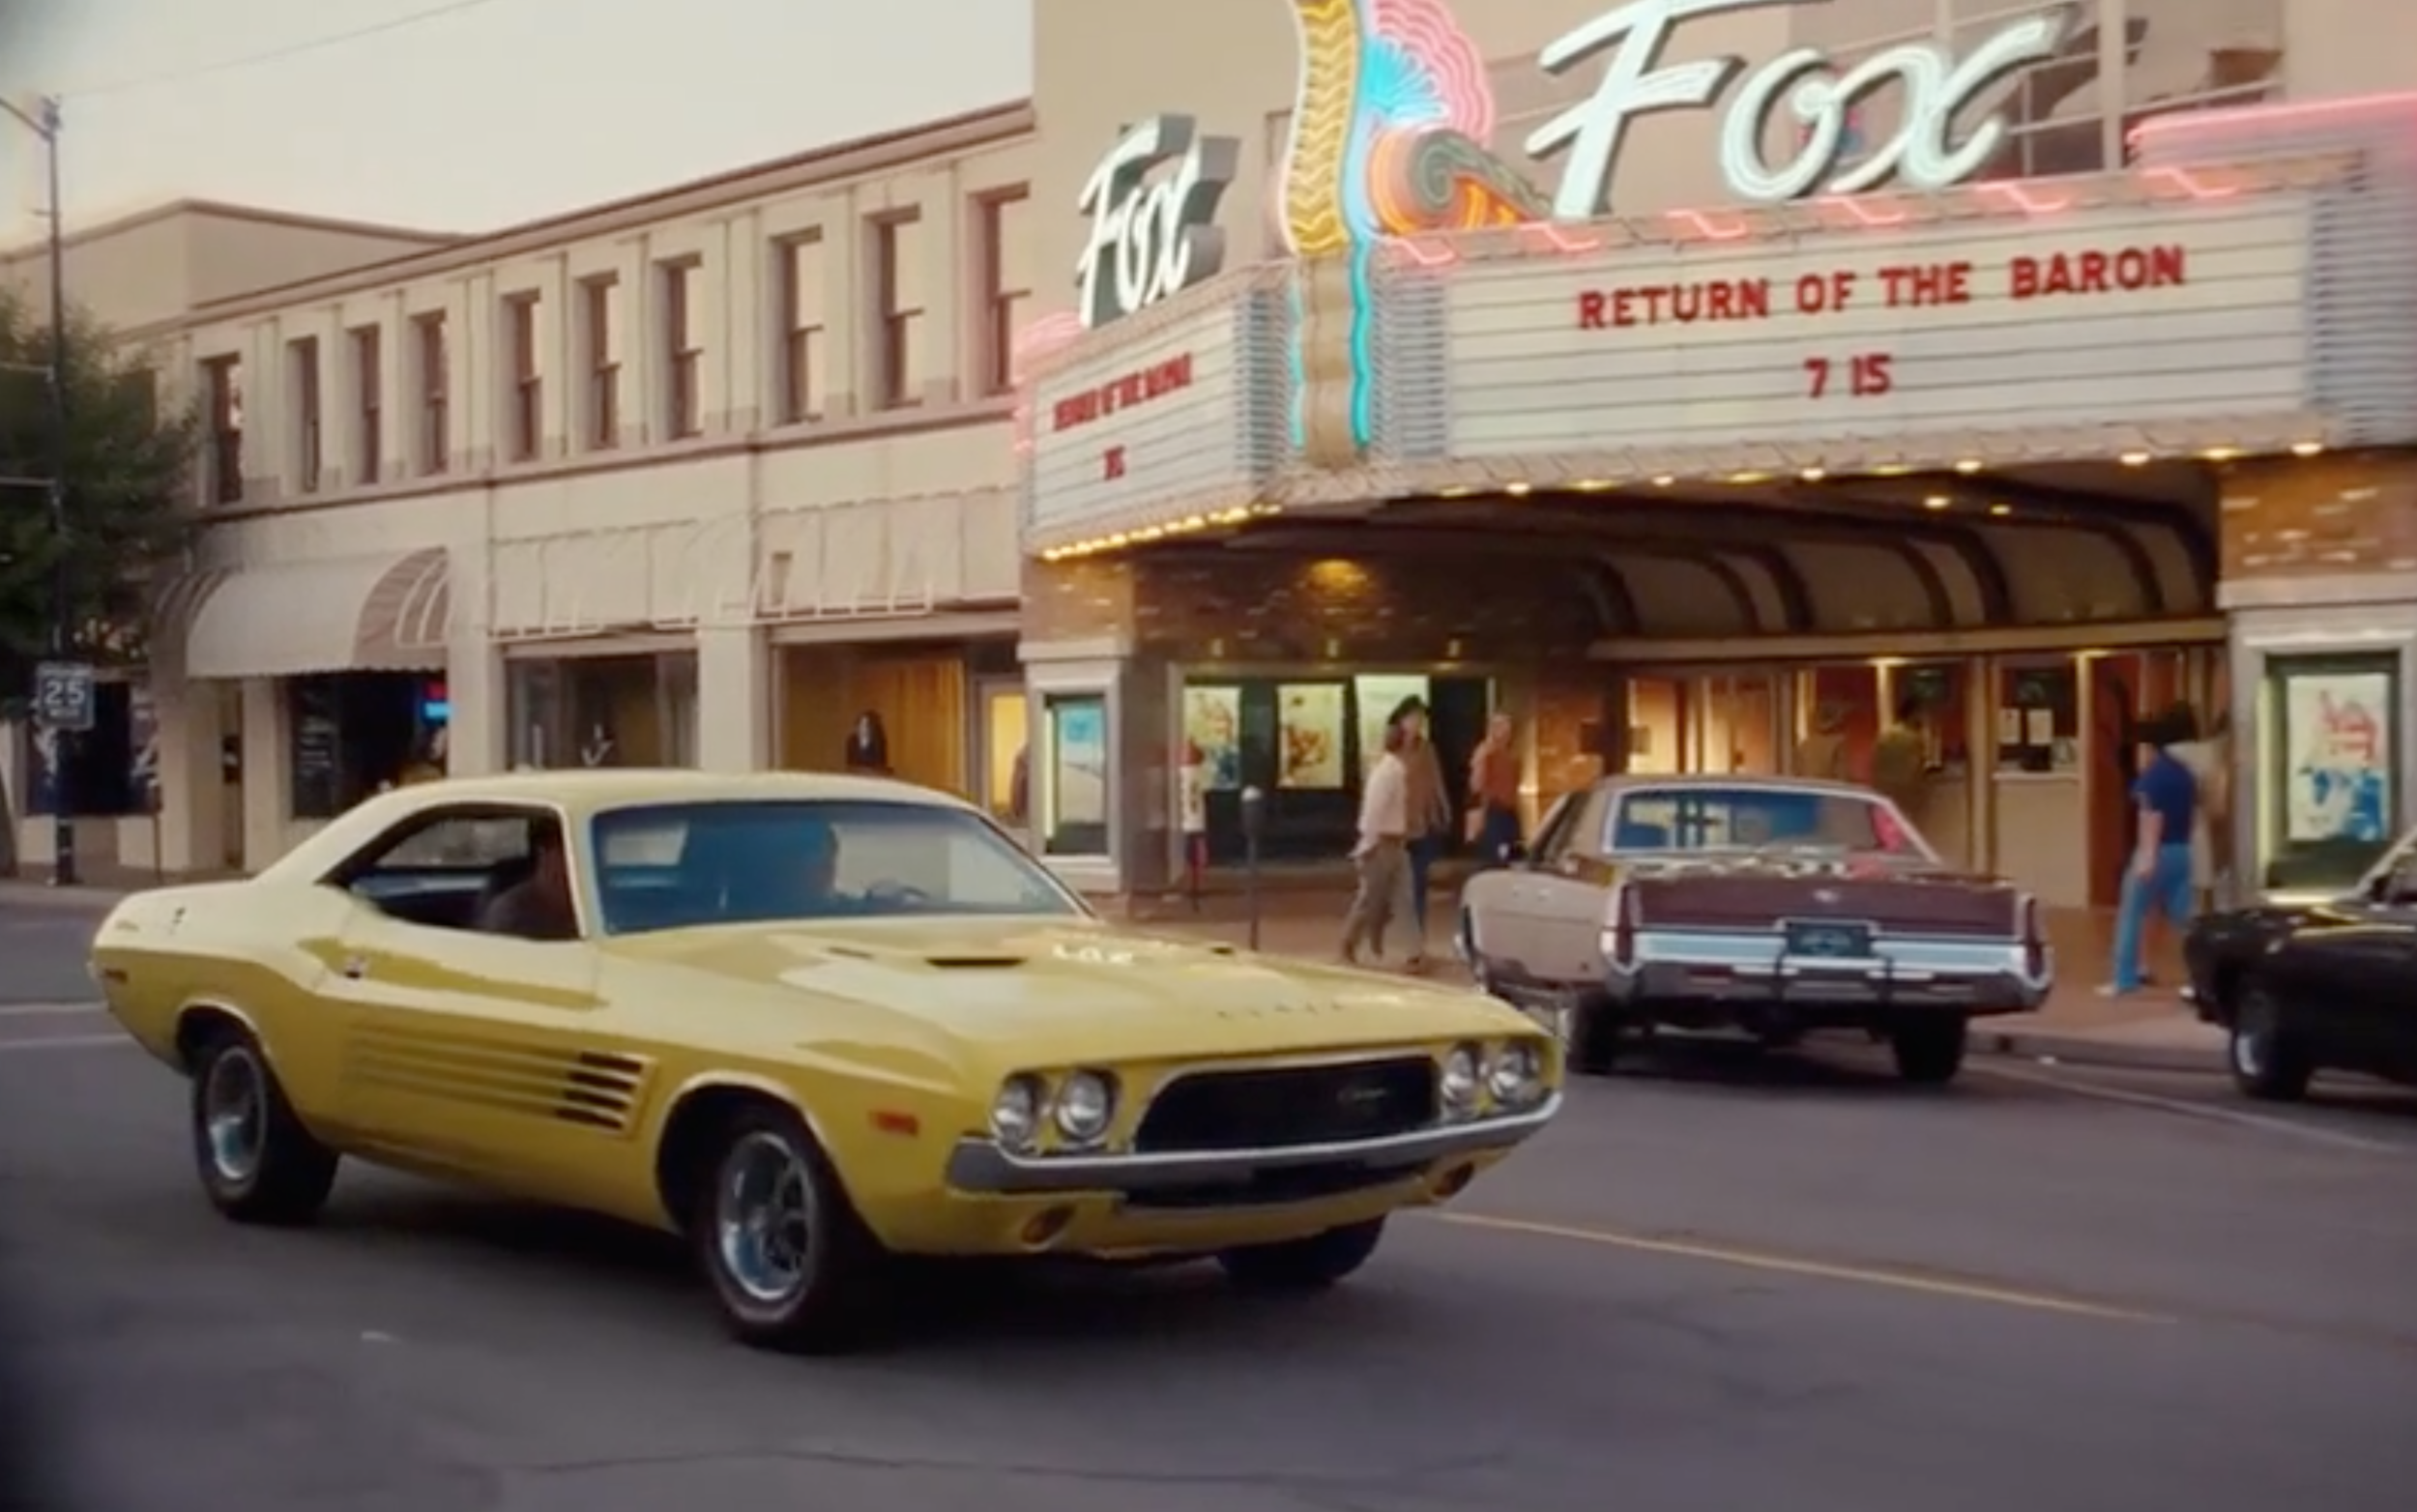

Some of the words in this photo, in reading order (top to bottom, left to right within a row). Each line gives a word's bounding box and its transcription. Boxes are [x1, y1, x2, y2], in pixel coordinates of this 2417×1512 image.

[1526, 0, 2061, 218] Fox
[1076, 112, 1204, 330] Fox
[1578, 279, 1769, 329] RETURN
[1795, 272, 1856, 314] OF
[1878, 262, 1971, 306] THE
[2010, 246, 2186, 299] BARON
[1804, 357, 1829, 397] 7
[1850, 354, 1892, 394] 15
[44, 678, 85, 705] 25
